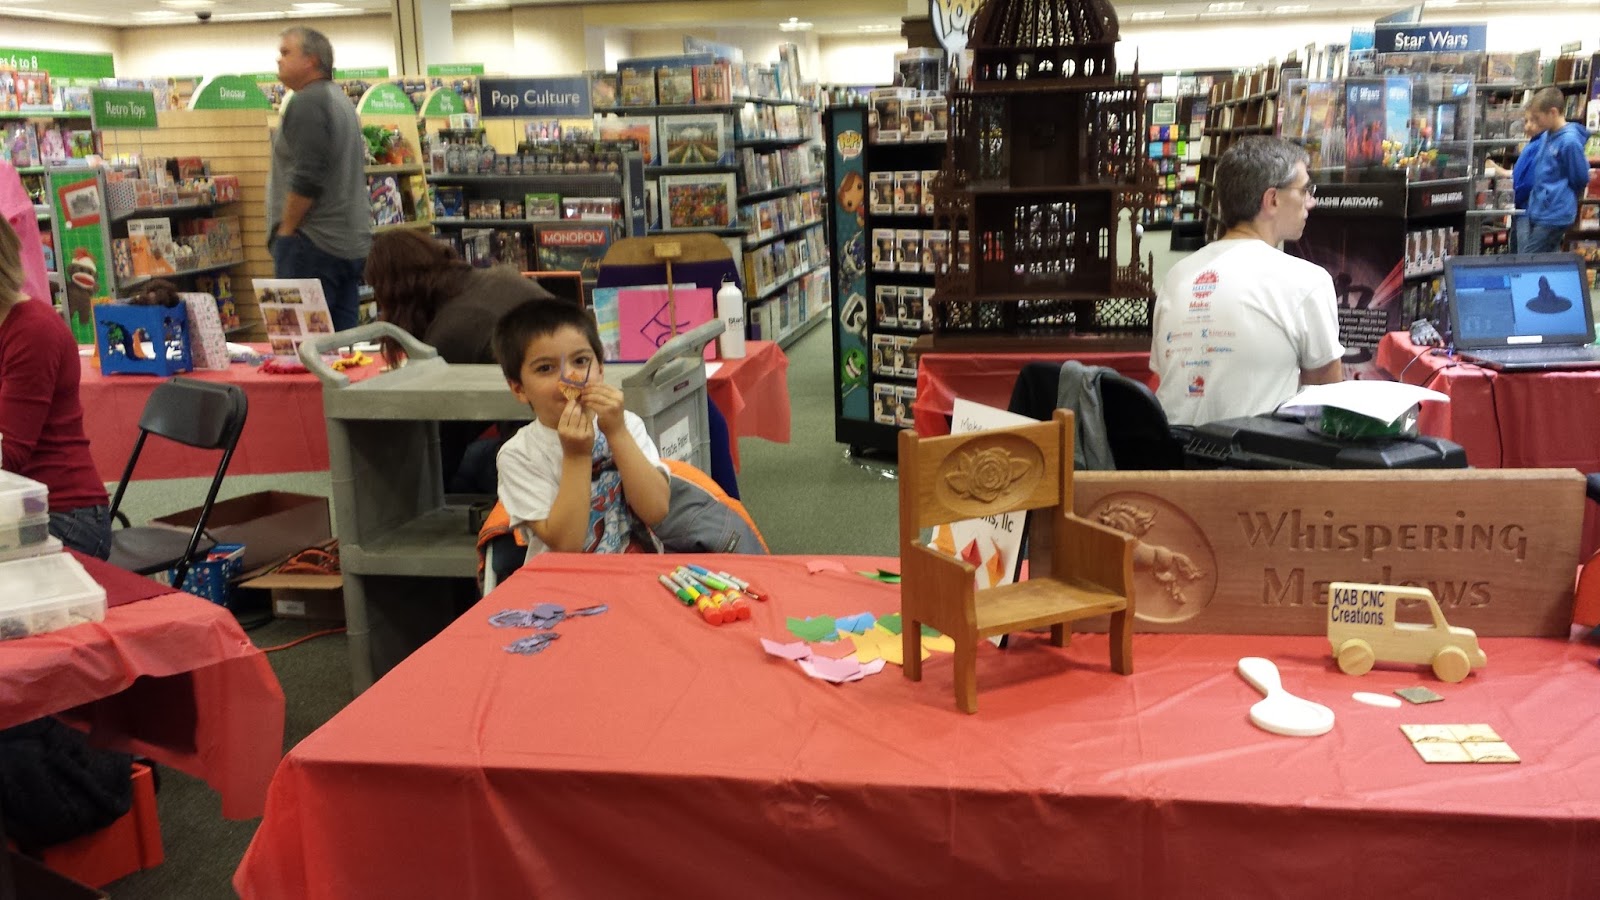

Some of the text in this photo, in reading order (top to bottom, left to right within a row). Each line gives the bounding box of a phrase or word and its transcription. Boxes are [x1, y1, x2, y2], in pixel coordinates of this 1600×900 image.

[1395, 31, 1468, 48] Star Wars
[11, 55, 17, 67] 6
[19, 58, 29, 67] to
[31, 56, 38, 67] 8
[219, 87, 246, 98] Dinosaur
[491, 89, 580, 110] Pop Culture
[105, 101, 146, 118] Retro Toys
[544, 231, 604, 243] MONOPOLY
[1262, 565, 1492, 607] Meows
[1334, 588, 1385, 608] KAB CNC
[1331, 604, 1385, 625] Creations
